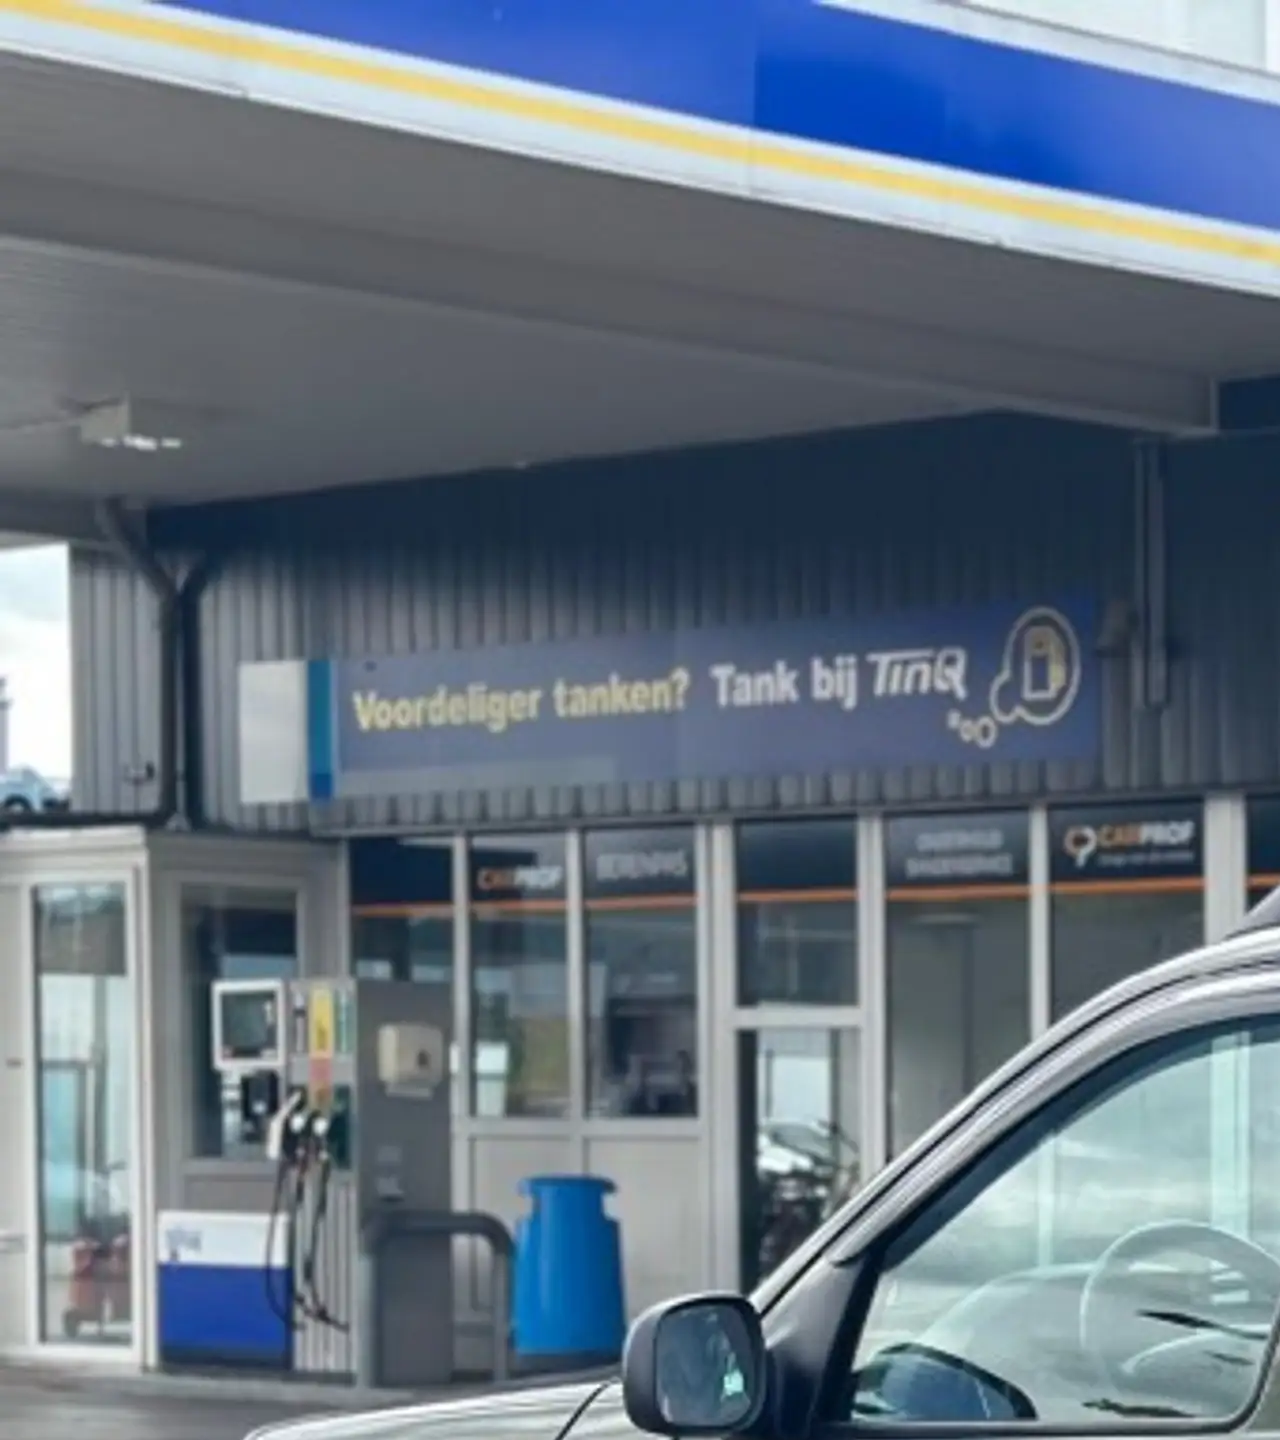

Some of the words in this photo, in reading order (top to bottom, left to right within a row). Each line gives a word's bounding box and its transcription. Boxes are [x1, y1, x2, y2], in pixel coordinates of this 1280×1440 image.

[353, 682, 543, 733] Voordeliger
[553, 666, 690, 718] tanken?
[709, 659, 800, 708] Tank
[810, 653, 858, 711] bij
